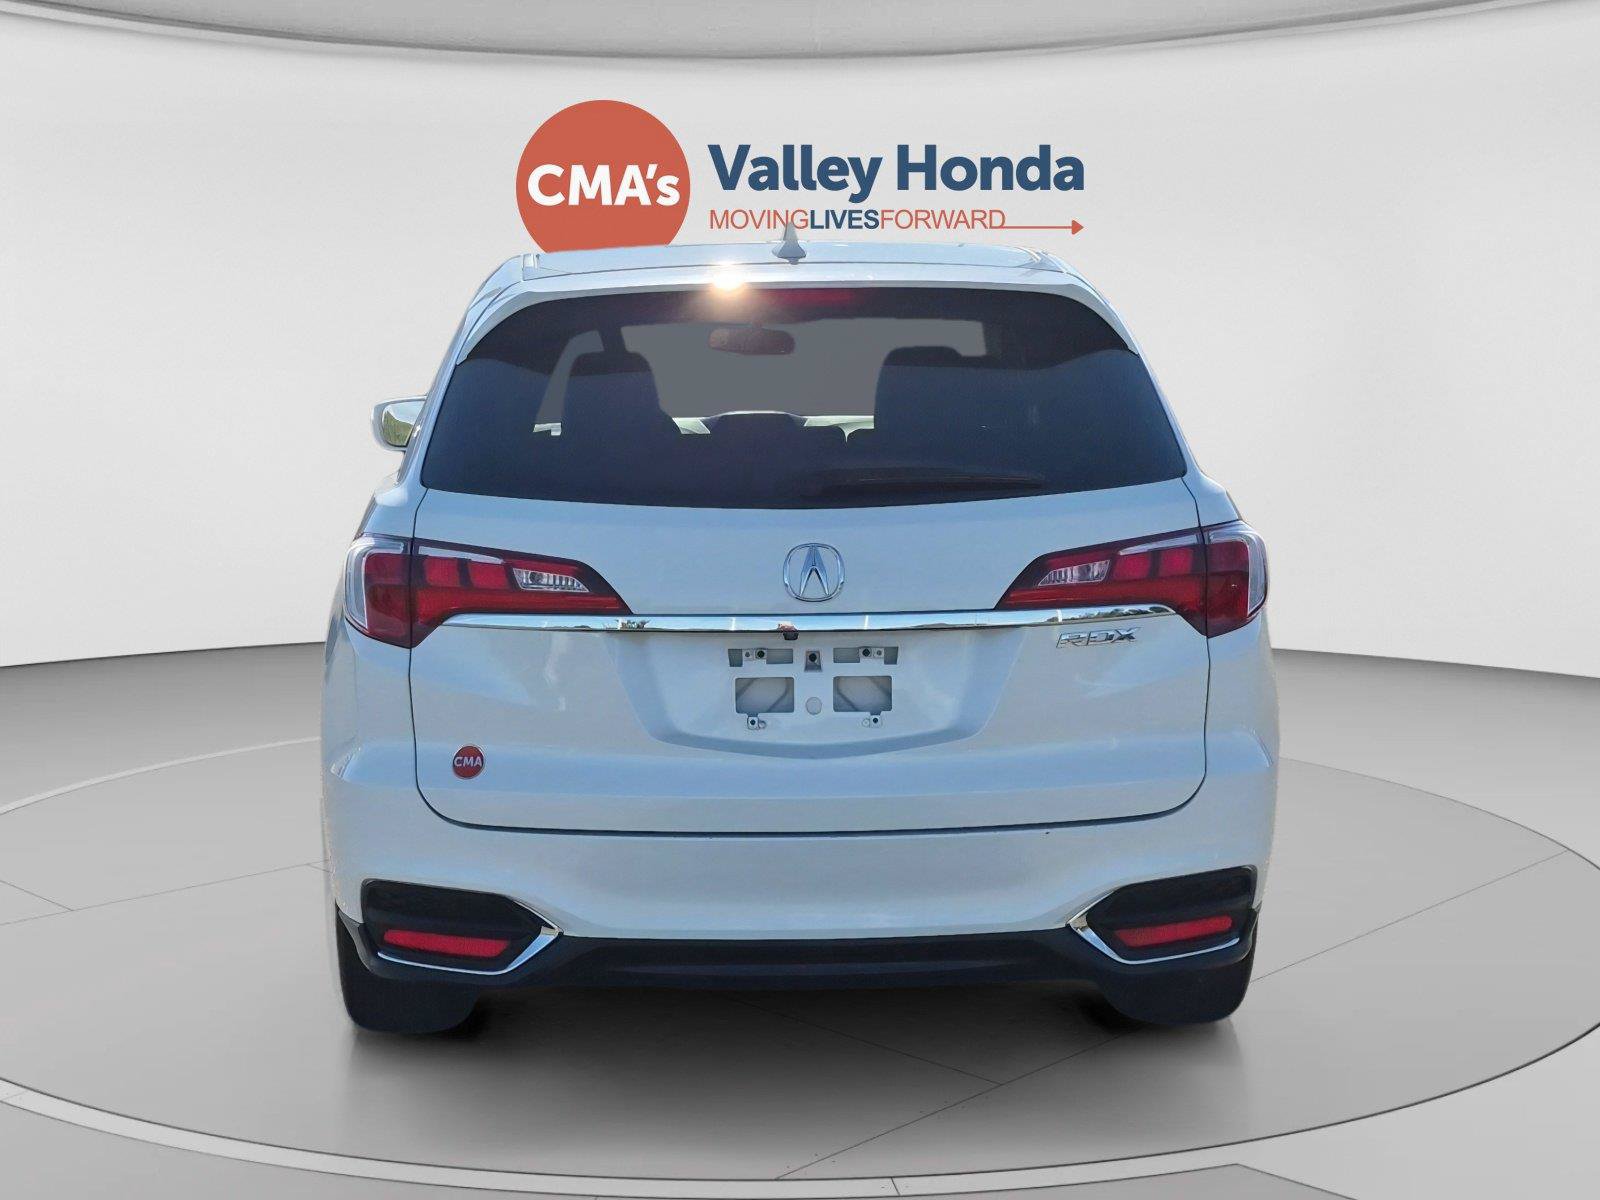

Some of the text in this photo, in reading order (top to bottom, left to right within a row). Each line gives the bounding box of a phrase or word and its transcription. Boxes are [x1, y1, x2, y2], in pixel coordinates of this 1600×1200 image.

[527, 163, 680, 206] CMA's
[708, 144, 1085, 204] Valley Honda
[1056, 627, 1140, 649] RDX
[453, 756, 483, 767] CMA
